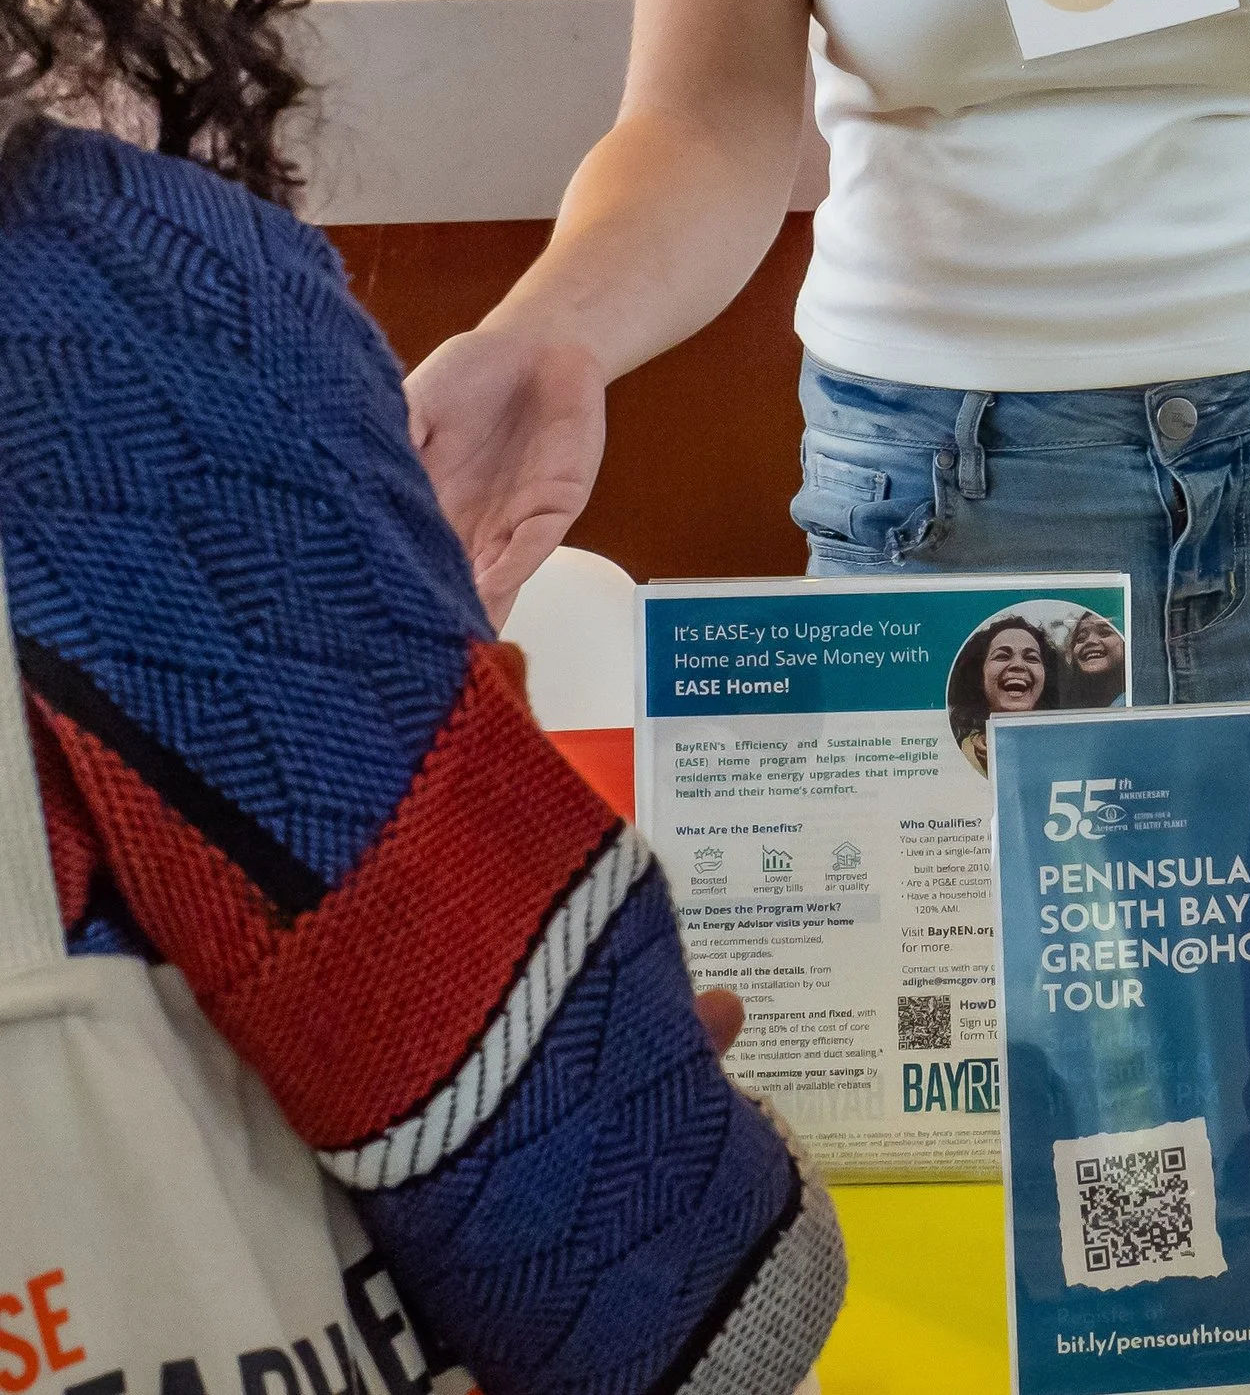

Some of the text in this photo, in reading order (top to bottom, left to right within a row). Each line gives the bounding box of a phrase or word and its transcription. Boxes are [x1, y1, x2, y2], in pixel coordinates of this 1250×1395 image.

[675, 621, 921, 644] It's EASE-y to Upgrade Your
[675, 646, 928, 668] Home and Save Money with
[676, 678, 789, 696] EASE Home!
[676, 737, 938, 754] BayREN's Efficiency and Sustainable Energy
[675, 751, 938, 768] (EASE) Home program helps income-eligible
[676, 768, 938, 782] residents make energy upgrades that improve
[676, 784, 857, 798] health and their home's comfort.
[1119, 790, 1170, 800] ANNIVERSARY
[676, 824, 803, 835] What Are the Benefits?
[900, 818, 982, 830] Who Qualifies?
[936, 864, 965, 873] before
[691, 874, 727, 885] Boosted
[765, 875, 792, 883] Lower
[825, 871, 867, 882] Improved
[1040, 855, 1250, 895] PENINSULA
[839, 882, 870, 892] quality
[932, 878, 956, 886] PG&E
[959, 878, 992, 886] custom
[692, 886, 726, 895] comfort
[754, 884, 803, 894] energy bills
[705, 906, 731, 915] Does
[735, 905, 753, 914] the
[757, 905, 803, 916] Program
[806, 903, 841, 912] Work?
[916, 906, 938, 914] 120%
[1040, 894, 1250, 935] SOUTH BAY
[688, 918, 854, 931] An Energy Advisor visits your home
[902, 928, 923, 936] Visit
[690, 935, 823, 946] and recommends customized,
[902, 942, 918, 952] for
[706, 968, 738, 976] handle
[740, 968, 752, 976] all
[1042, 979, 1146, 1013] TOUR
[960, 999, 996, 1010] HowD
[749, 1012, 805, 1021] transparent
[809, 1010, 826, 1018] and
[960, 1018, 997, 1030] Sign up
[737, 1068, 864, 1079] will maximize your savings
